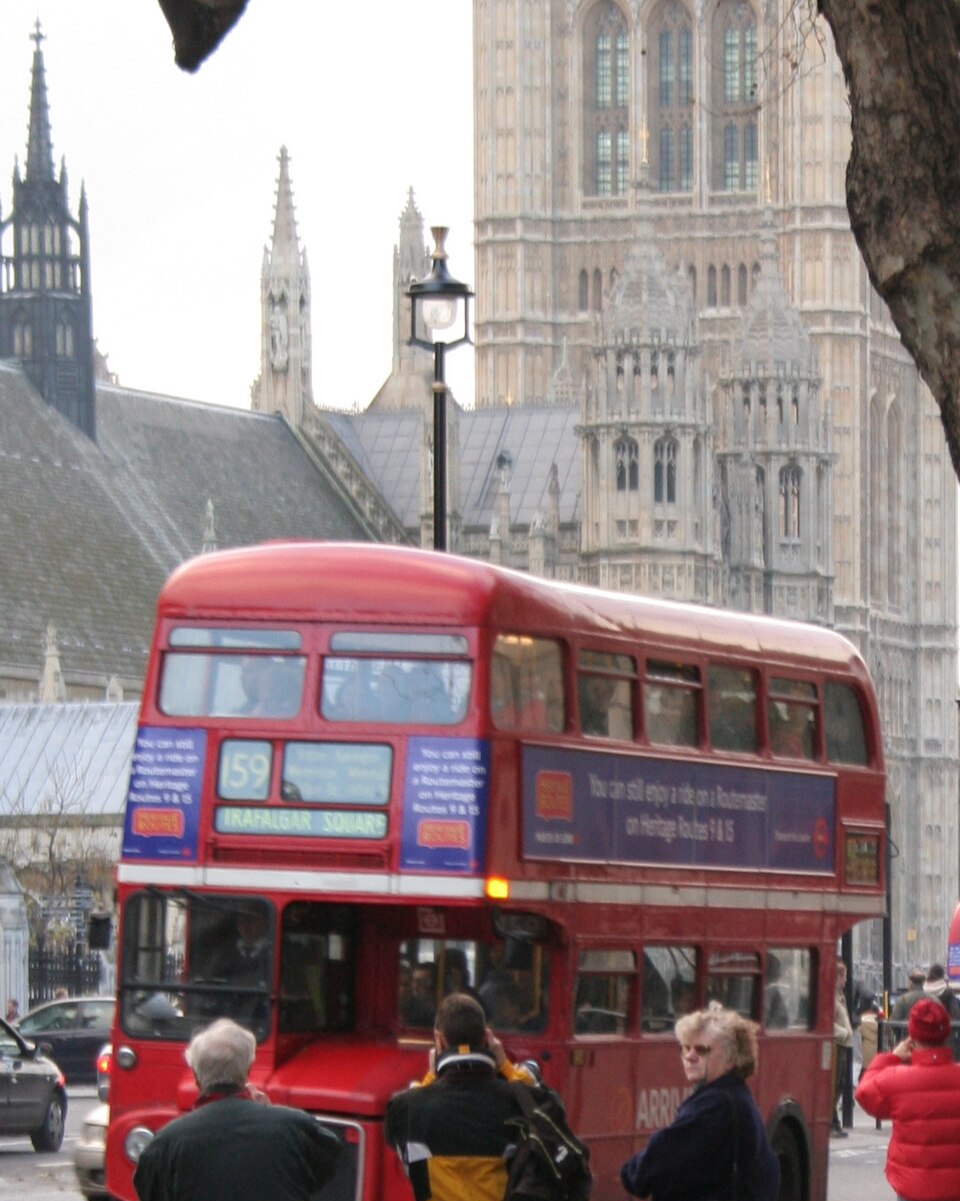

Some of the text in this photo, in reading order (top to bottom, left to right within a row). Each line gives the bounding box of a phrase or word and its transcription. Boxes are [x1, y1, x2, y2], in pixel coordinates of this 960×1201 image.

[421, 748, 481, 761] You can still
[220, 752, 269, 790] 159
[421, 776, 485, 789] Routemaster
[223, 807, 313, 832] TRAFALGAR
